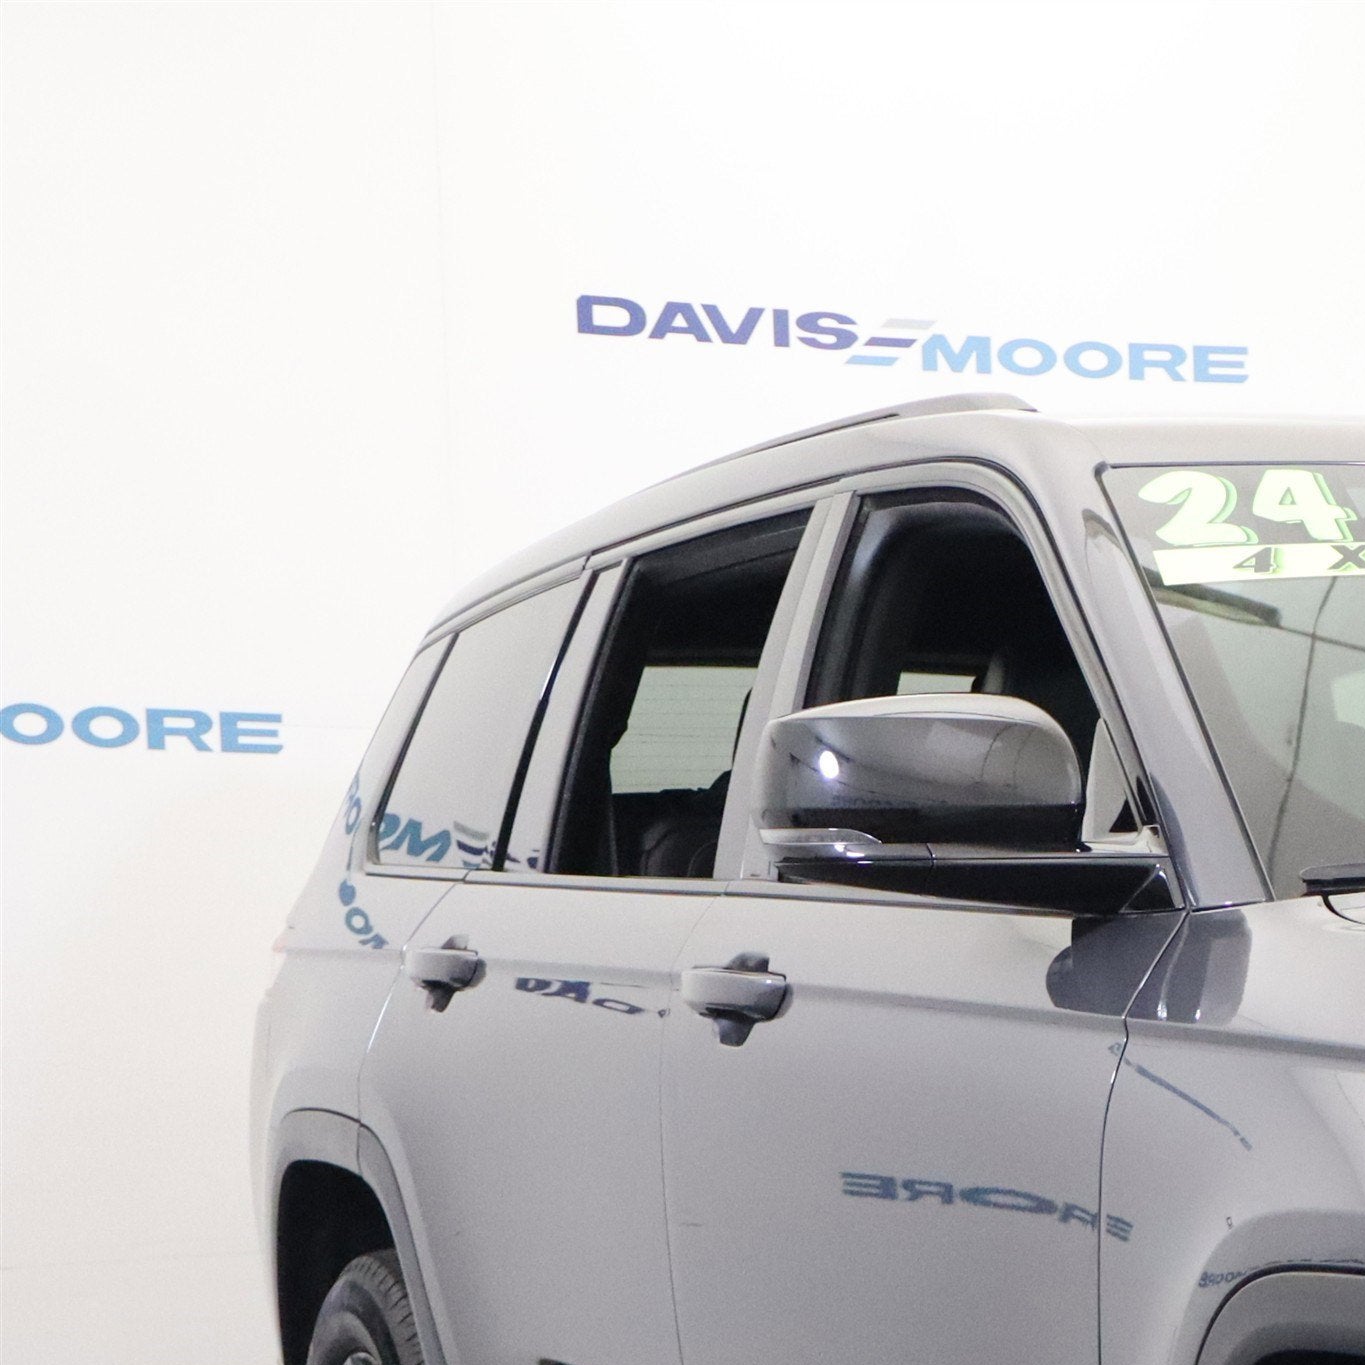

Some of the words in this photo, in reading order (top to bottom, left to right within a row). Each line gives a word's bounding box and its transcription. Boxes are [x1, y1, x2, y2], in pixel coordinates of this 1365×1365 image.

[577, 294, 860, 350] DAVIS
[922, 333, 1249, 384] MOORE
[1137, 468, 1358, 547] 24
